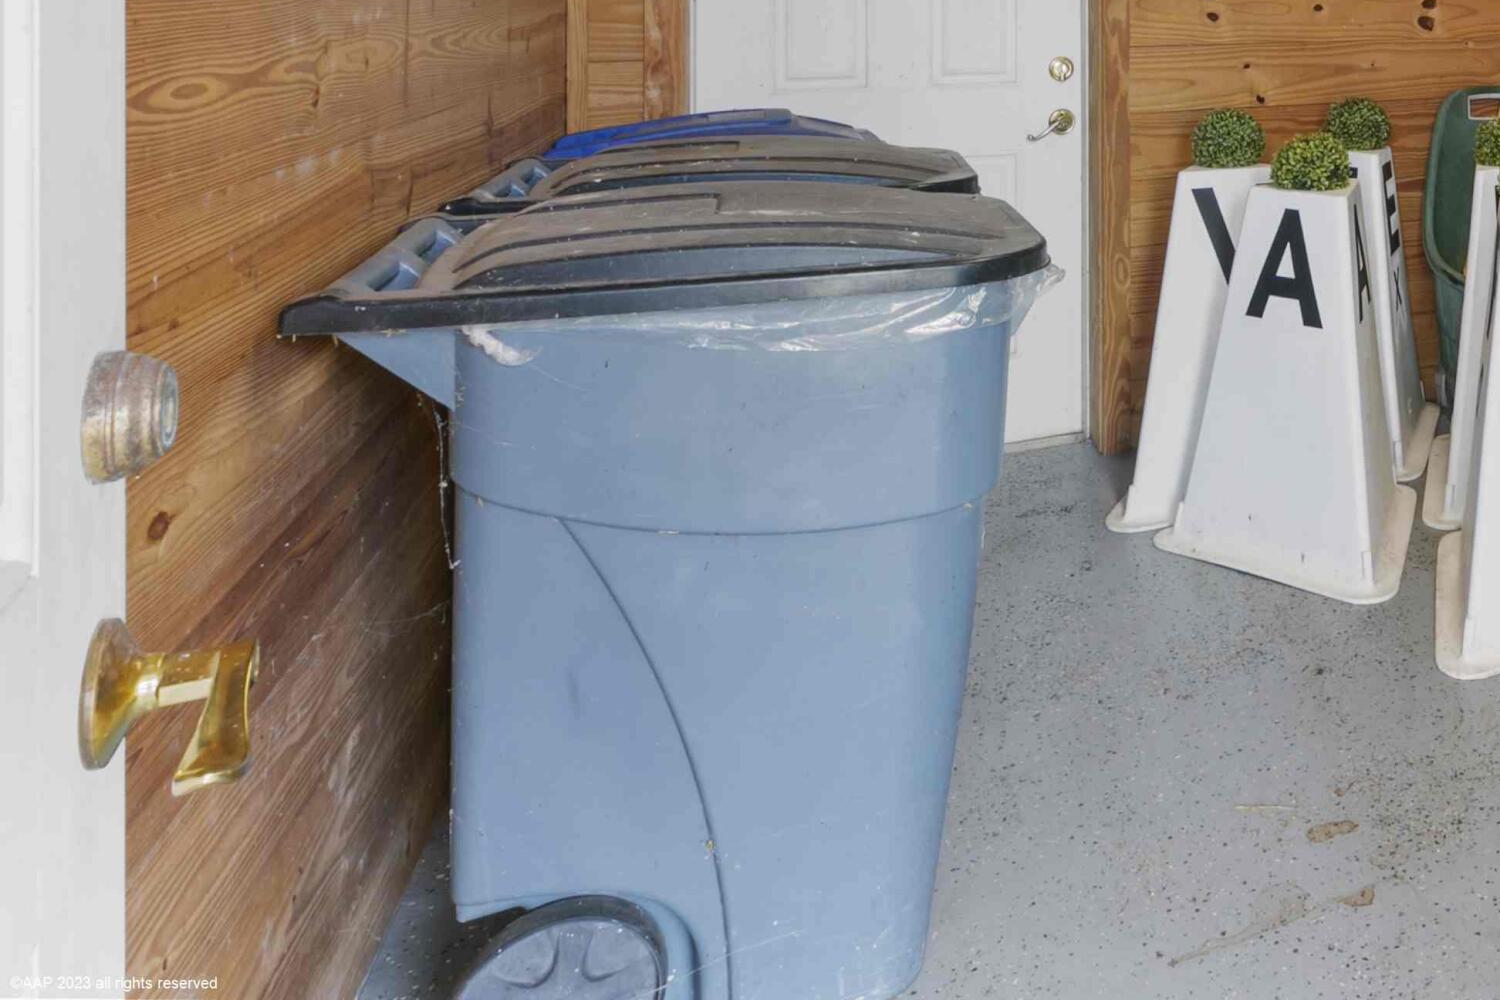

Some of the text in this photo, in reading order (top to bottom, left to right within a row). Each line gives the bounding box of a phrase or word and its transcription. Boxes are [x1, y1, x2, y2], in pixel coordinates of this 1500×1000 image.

[1245, 208, 1323, 328] A
[1353, 203, 1371, 324] A
[1382, 160, 1400, 257] E
